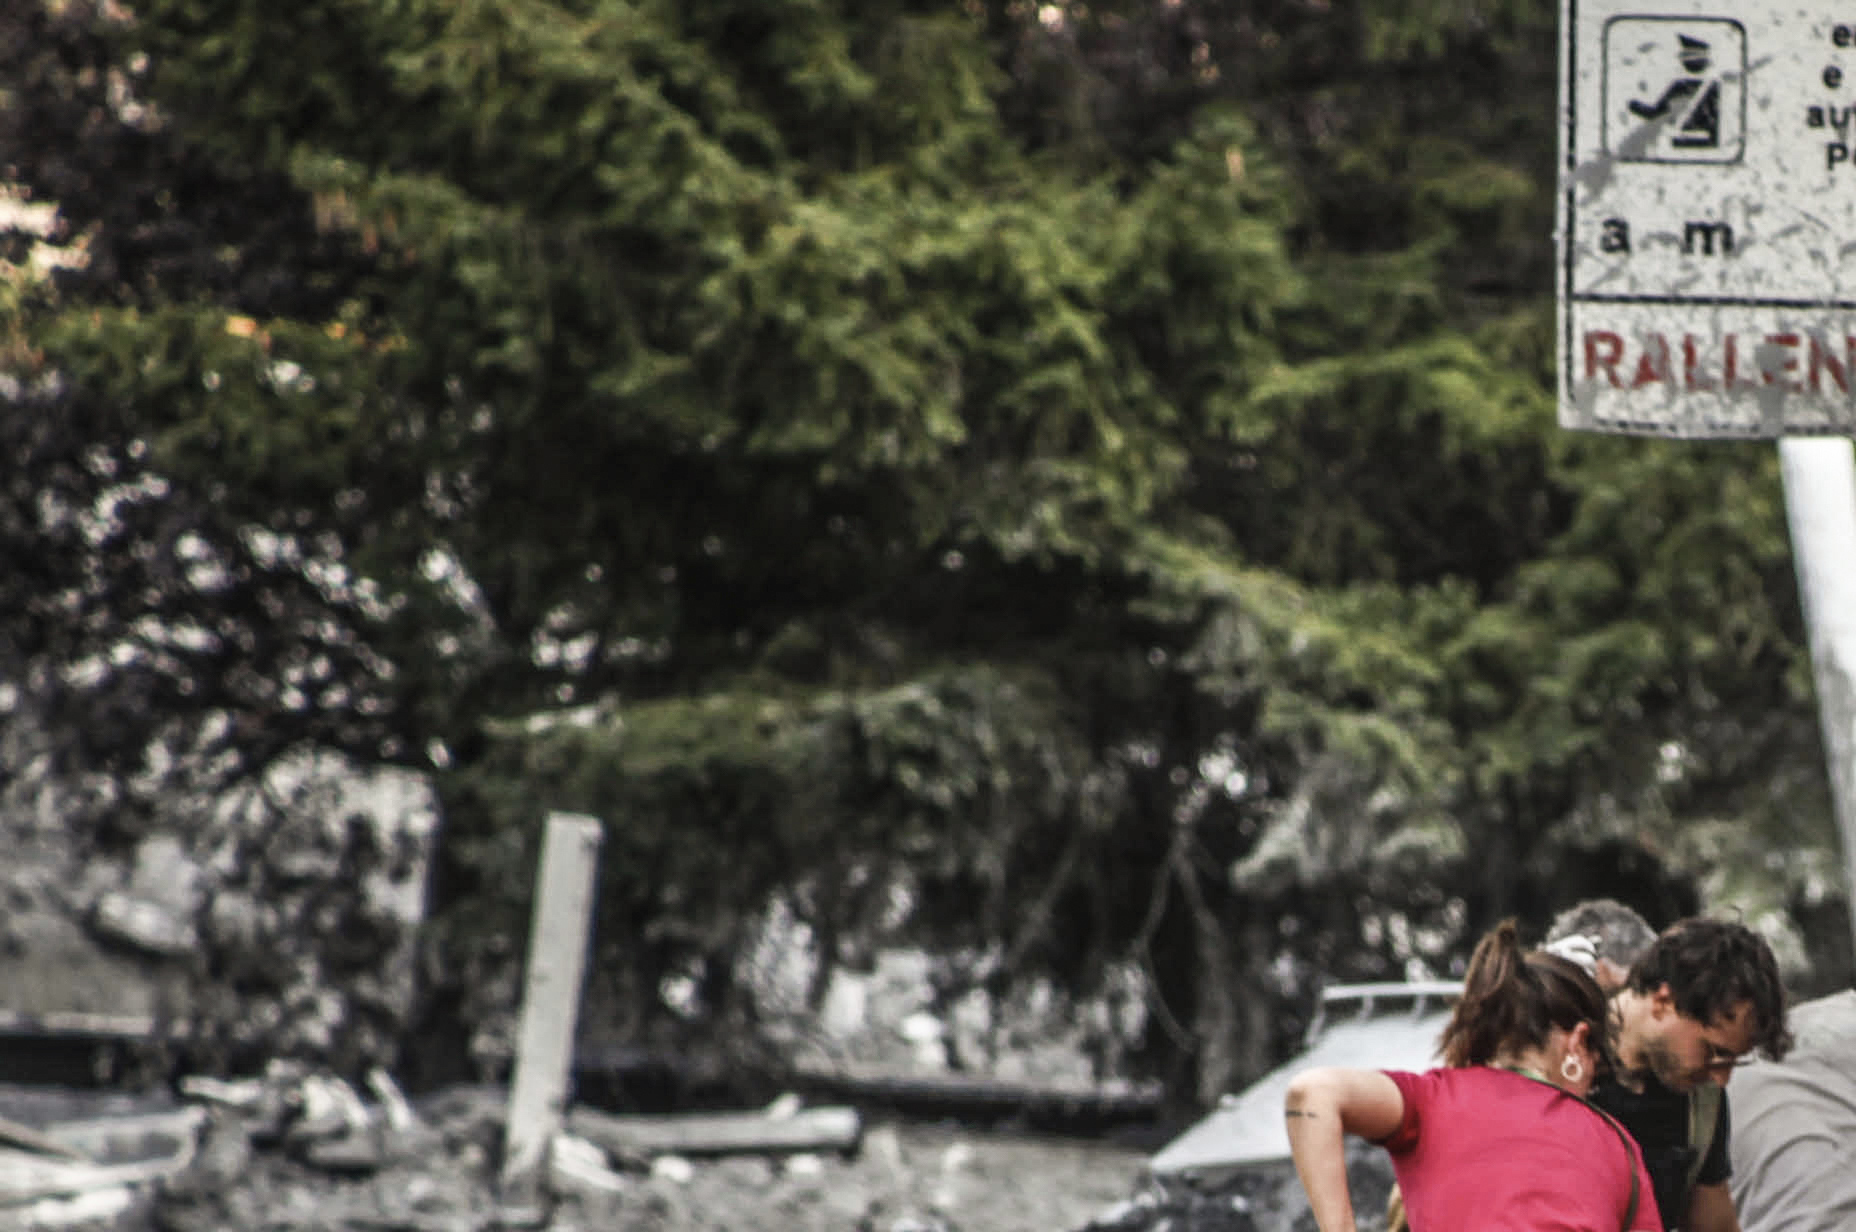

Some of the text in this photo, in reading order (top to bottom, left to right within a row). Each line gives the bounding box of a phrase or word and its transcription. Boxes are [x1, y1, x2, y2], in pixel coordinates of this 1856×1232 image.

[1822, 64, 1843, 89] e
[1602, 218, 1735, 256] a m
